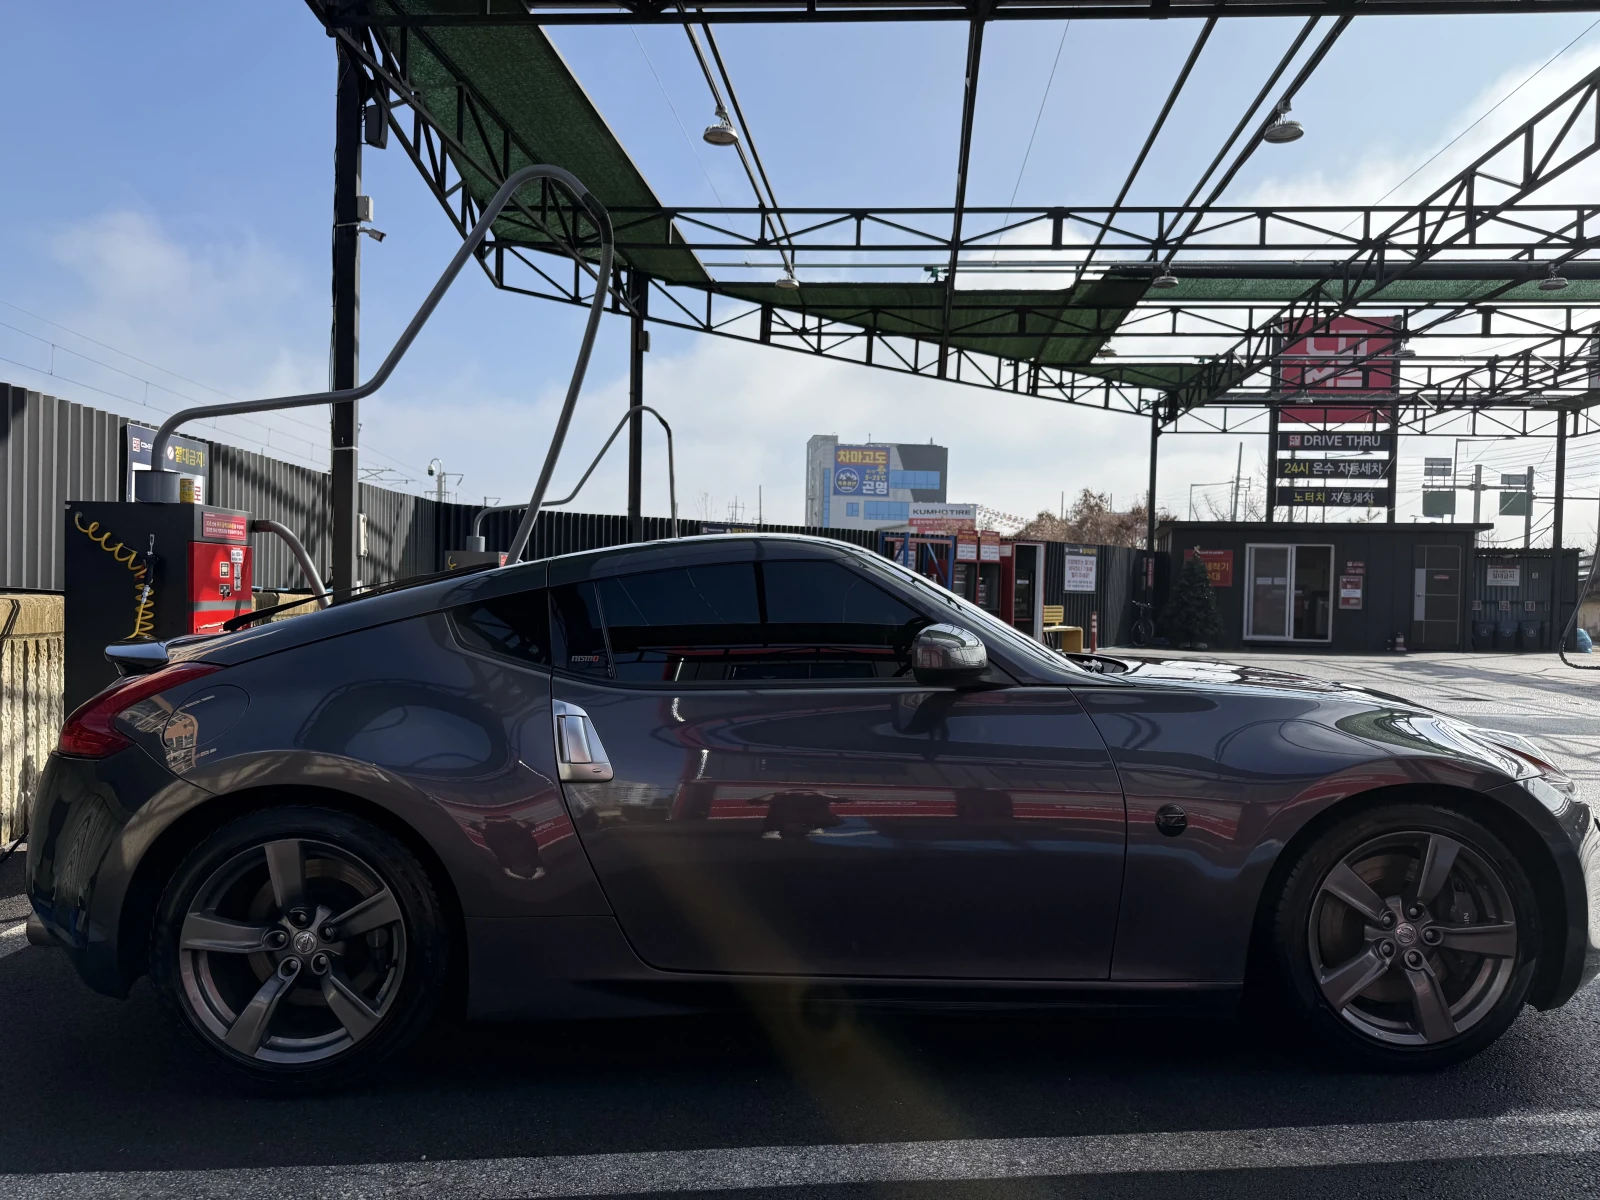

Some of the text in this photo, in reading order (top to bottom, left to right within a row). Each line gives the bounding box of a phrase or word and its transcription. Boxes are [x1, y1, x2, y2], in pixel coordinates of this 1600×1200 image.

[1303, 435, 1381, 447] DRIVE THRU
[174, 445, 206, 468] 절대금지!
[837, 450, 887, 464] 차마고도
[1284, 462, 1383, 475] 24시 온수 자동세차
[862, 480, 888, 495] 곤명
[1293, 492, 1375, 504] 노터치 자동세차
